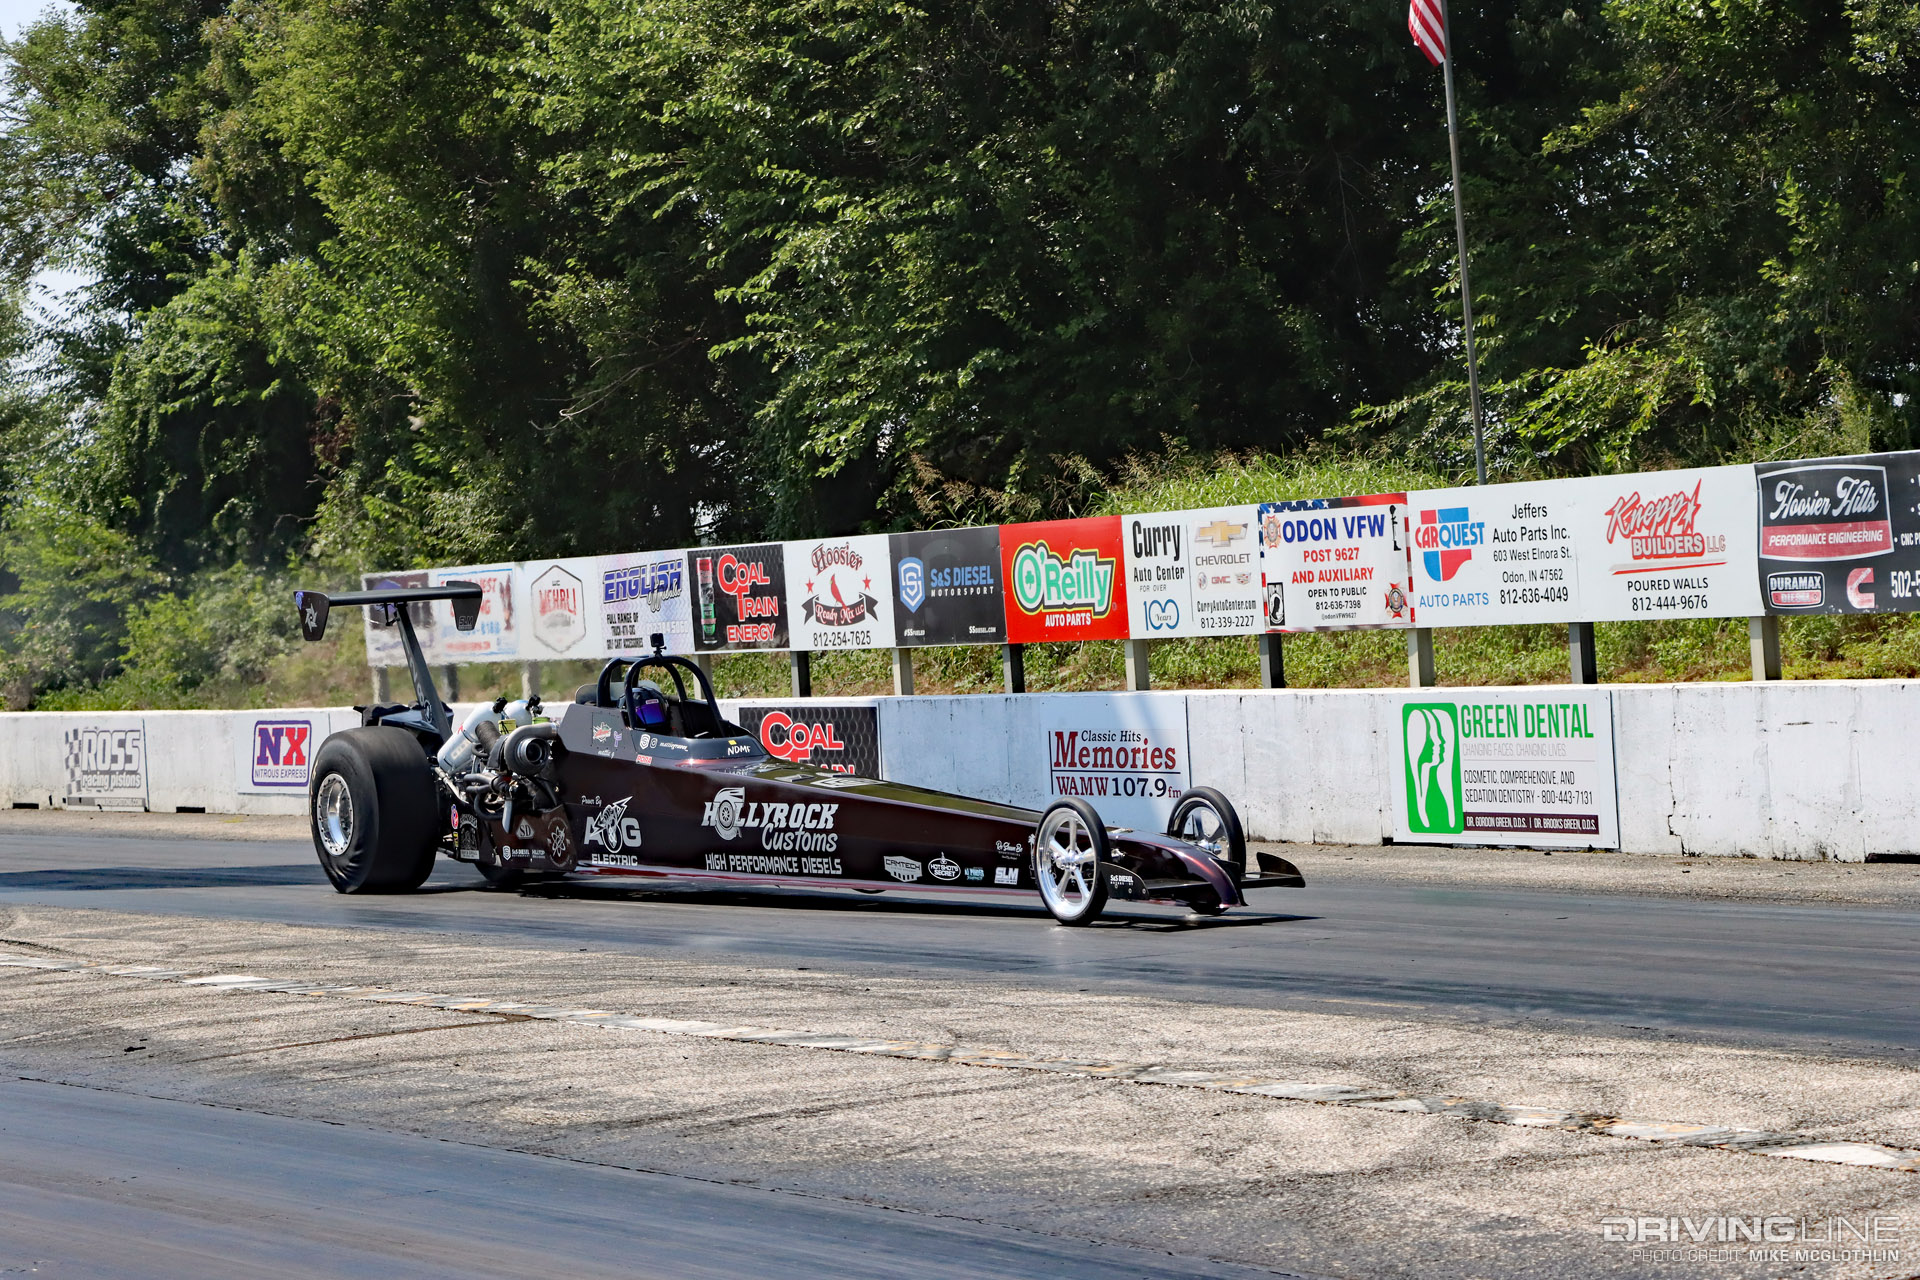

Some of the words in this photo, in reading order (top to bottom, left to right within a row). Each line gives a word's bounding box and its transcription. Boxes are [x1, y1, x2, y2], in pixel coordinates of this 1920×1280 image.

[1770, 480, 1831, 520] Hoosier
[1832, 476, 1879, 517] Hills
[1512, 503, 1548, 520] Jeffers
[1283, 517, 1337, 543] ODON
[1342, 514, 1385, 538] VFW
[1415, 522, 1485, 549] CARQUEST
[1493, 528, 1517, 543] Auto
[1521, 526, 1548, 541] Parts
[1551, 524, 1570, 539] Inc.
[1132, 520, 1180, 561] Curry
[1632, 533, 1704, 560] BUILDERS
[1706, 535, 1726, 552] LLC
[1768, 533, 1826, 546] PERFORMANCE
[1828, 530, 1883, 544] ENGINEERING
[1901, 533, 1913, 546] CNC
[811, 542, 863, 575] Hoosier
[1195, 553, 1250, 566] CHEVROLET
[1303, 549, 1332, 562] POST
[1335, 547, 1360, 561] 9627
[1493, 550, 1507, 562] 603
[1509, 548, 1530, 560] West
[1532, 548, 1558, 560] Elnora
[1561, 546, 1572, 558] St.
[603, 558, 683, 604] ENGLISH
[717, 554, 770, 594] COAL
[930, 568, 950, 588] S&S
[953, 565, 994, 586] DIESEL
[1018, 551, 1108, 607] O'Reilly
[1134, 567, 1152, 582] Auto
[1157, 566, 1184, 580] Center
[1211, 576, 1231, 584] GMC
[1292, 571, 1314, 584] AND
[1318, 567, 1374, 582] AUXILIARY
[1502, 571, 1527, 584] Odon,
[1529, 570, 1537, 581] IN
[1540, 569, 1563, 581] 47562
[931, 586, 994, 597] MOTORSPORT
[1627, 579, 1670, 592] POURED
[1673, 578, 1708, 589] WALLS
[1770, 576, 1821, 590] DURAMAX
[1308, 588, 1327, 598] OPEN
[1330, 588, 1339, 597] TO
[1342, 586, 1367, 596] PUBLIC
[1420, 594, 1449, 608] AUTO
[1453, 592, 1489, 606] PARTS
[1500, 586, 1568, 604] 812-636-4049
[734, 584, 778, 622] TRAIN
[1197, 599, 1256, 613] CurryAutoCenter.com
[1316, 600, 1361, 610] 812-636-7398
[1632, 595, 1708, 611] 812-444-9676
[607, 614, 616, 624] FULL
[617, 613, 632, 623] RANGE
[633, 612, 638, 623] OF
[815, 604, 838, 626] Ready
[840, 608, 854, 624] Mix
[855, 603, 864, 616] LLC
[1045, 614, 1064, 627] AUTO
[1066, 612, 1091, 626] PARTS
[1144, 599, 1179, 631] 100
[1201, 615, 1254, 629] 812-339-2227
[727, 624, 776, 643] ENERGY
[813, 630, 871, 647] 812-254-7625
[1461, 704, 1518, 738] GREEN
[1524, 704, 1594, 738] DENTAL
[760, 711, 844, 758] COAL
[1081, 730, 1116, 742] Classic
[1120, 731, 1141, 742] Hits
[82, 730, 141, 772] ROSS
[256, 727, 308, 766] NX
[1054, 732, 1176, 770] Memories
[1463, 743, 1492, 756] CHANGING
[1516, 743, 1547, 756] CHANGING
[82, 772, 110, 791] racing
[110, 772, 141, 791] pistons
[255, 769, 279, 778] NITROUS
[280, 769, 306, 778] EXPRESS
[1464, 770, 1499, 784] COSMETIC,
[1500, 770, 1559, 785] COMPREHENSIVE,
[1561, 771, 1575, 785] AND
[1056, 776, 1109, 796] WAMW
[1112, 778, 1166, 797] 107.9
[1168, 786, 1181, 798] fm
[1465, 789, 1497, 802] SEDATION
[1499, 789, 1535, 803] DENTISTRY
[1542, 790, 1592, 804] 800-443-7131
[701, 800, 839, 830] HOLLYROCK
[1475, 817, 1495, 827] GORDON
[1534, 818, 1542, 828] DR.
[1543, 818, 1563, 829] BROOKS
[520, 825, 531, 837] SD
[762, 823, 838, 852] Customs
[592, 854, 638, 866] ELECTRIC
[705, 853, 727, 871] HIGH
[729, 854, 799, 874] PERFORMANCE
[802, 856, 842, 874] DIESELS
[996, 867, 1019, 880] SLM
